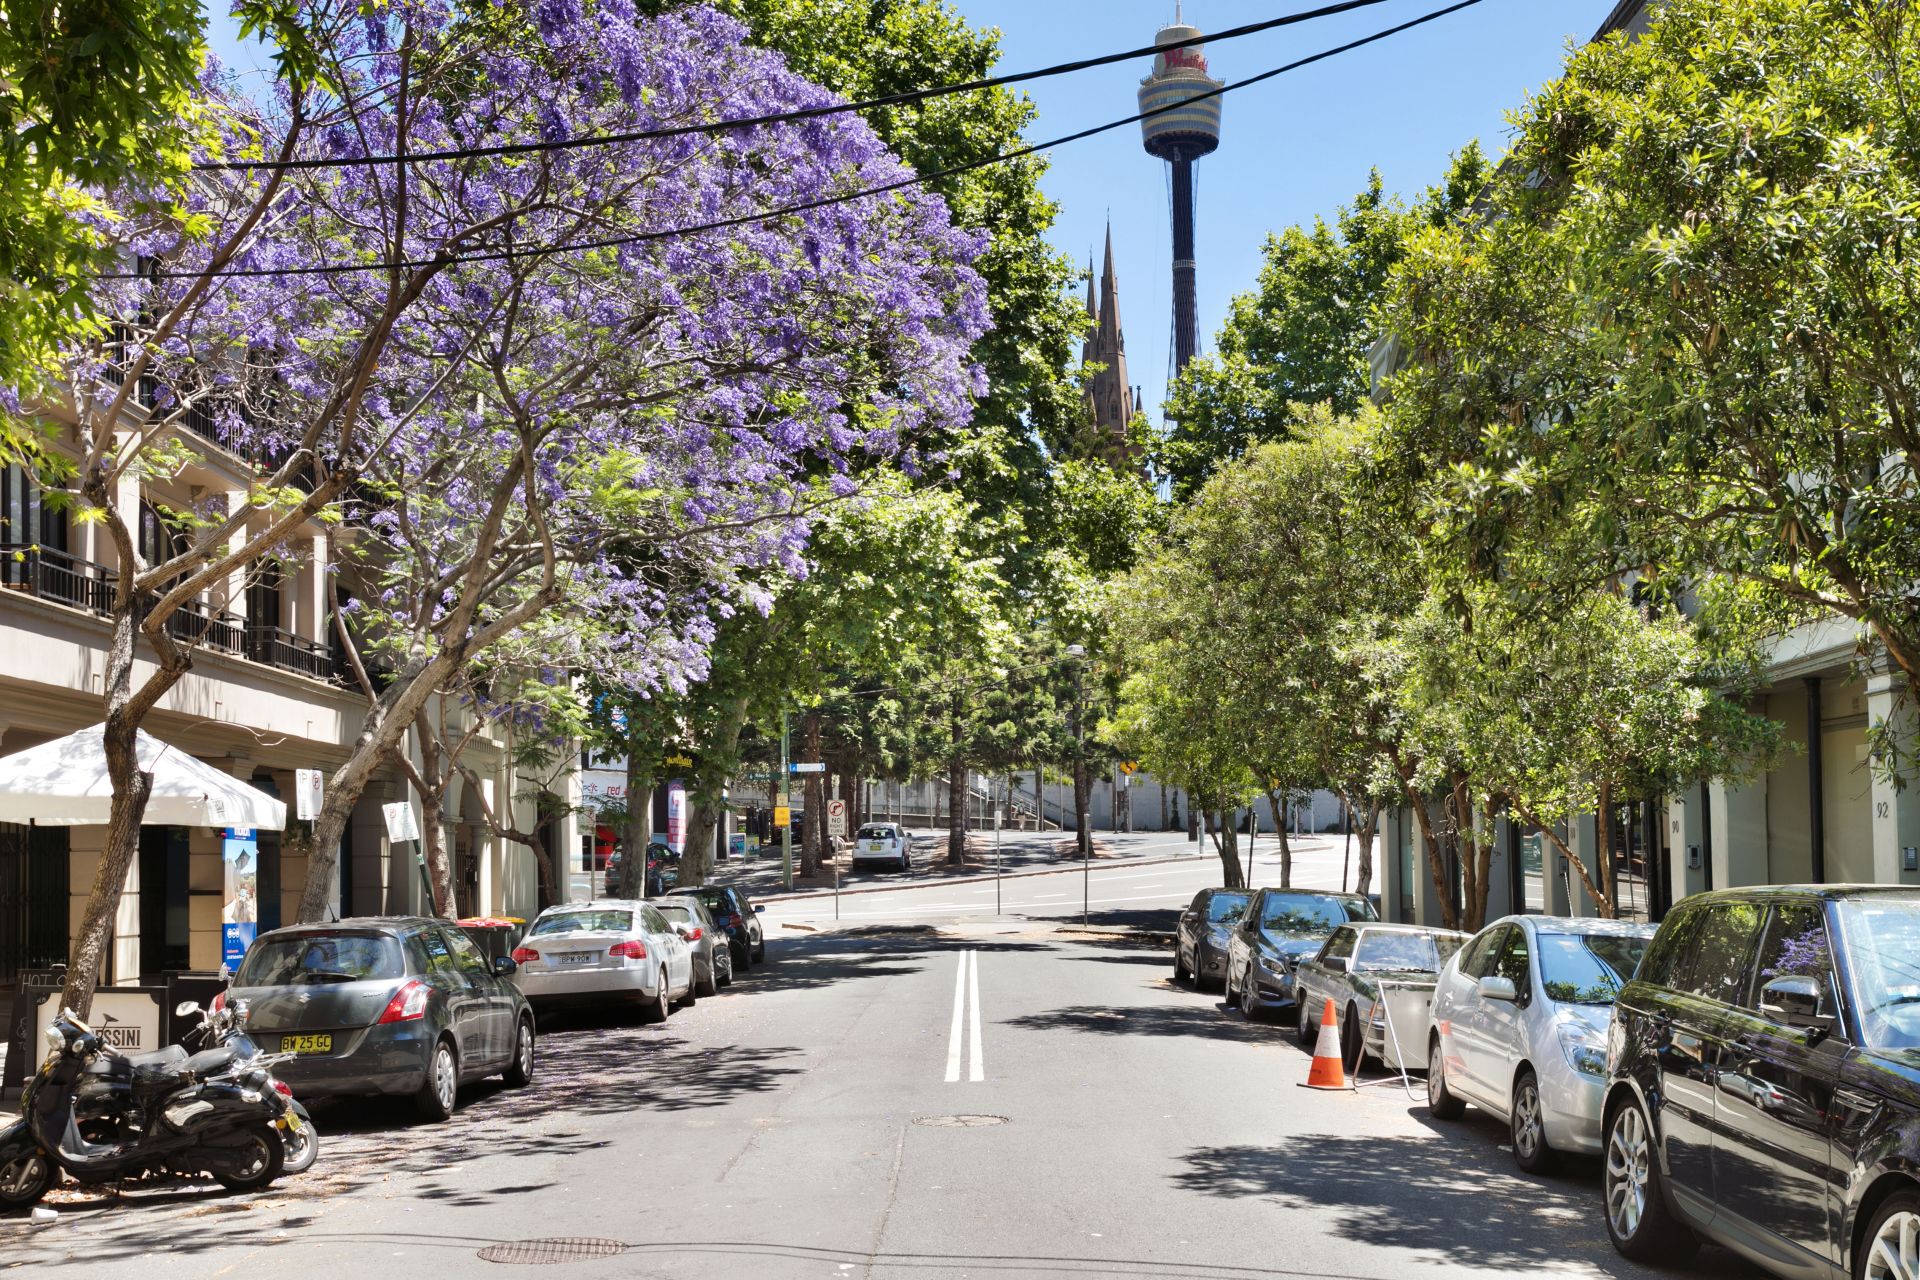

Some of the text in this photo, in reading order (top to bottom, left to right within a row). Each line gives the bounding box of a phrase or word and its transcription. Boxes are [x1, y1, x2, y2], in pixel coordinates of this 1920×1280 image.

[607, 784, 621, 796] red
[1877, 801, 1889, 818] 92
[1671, 820, 1680, 834] 90
[282, 1035, 331, 1050] BW 25 GC
